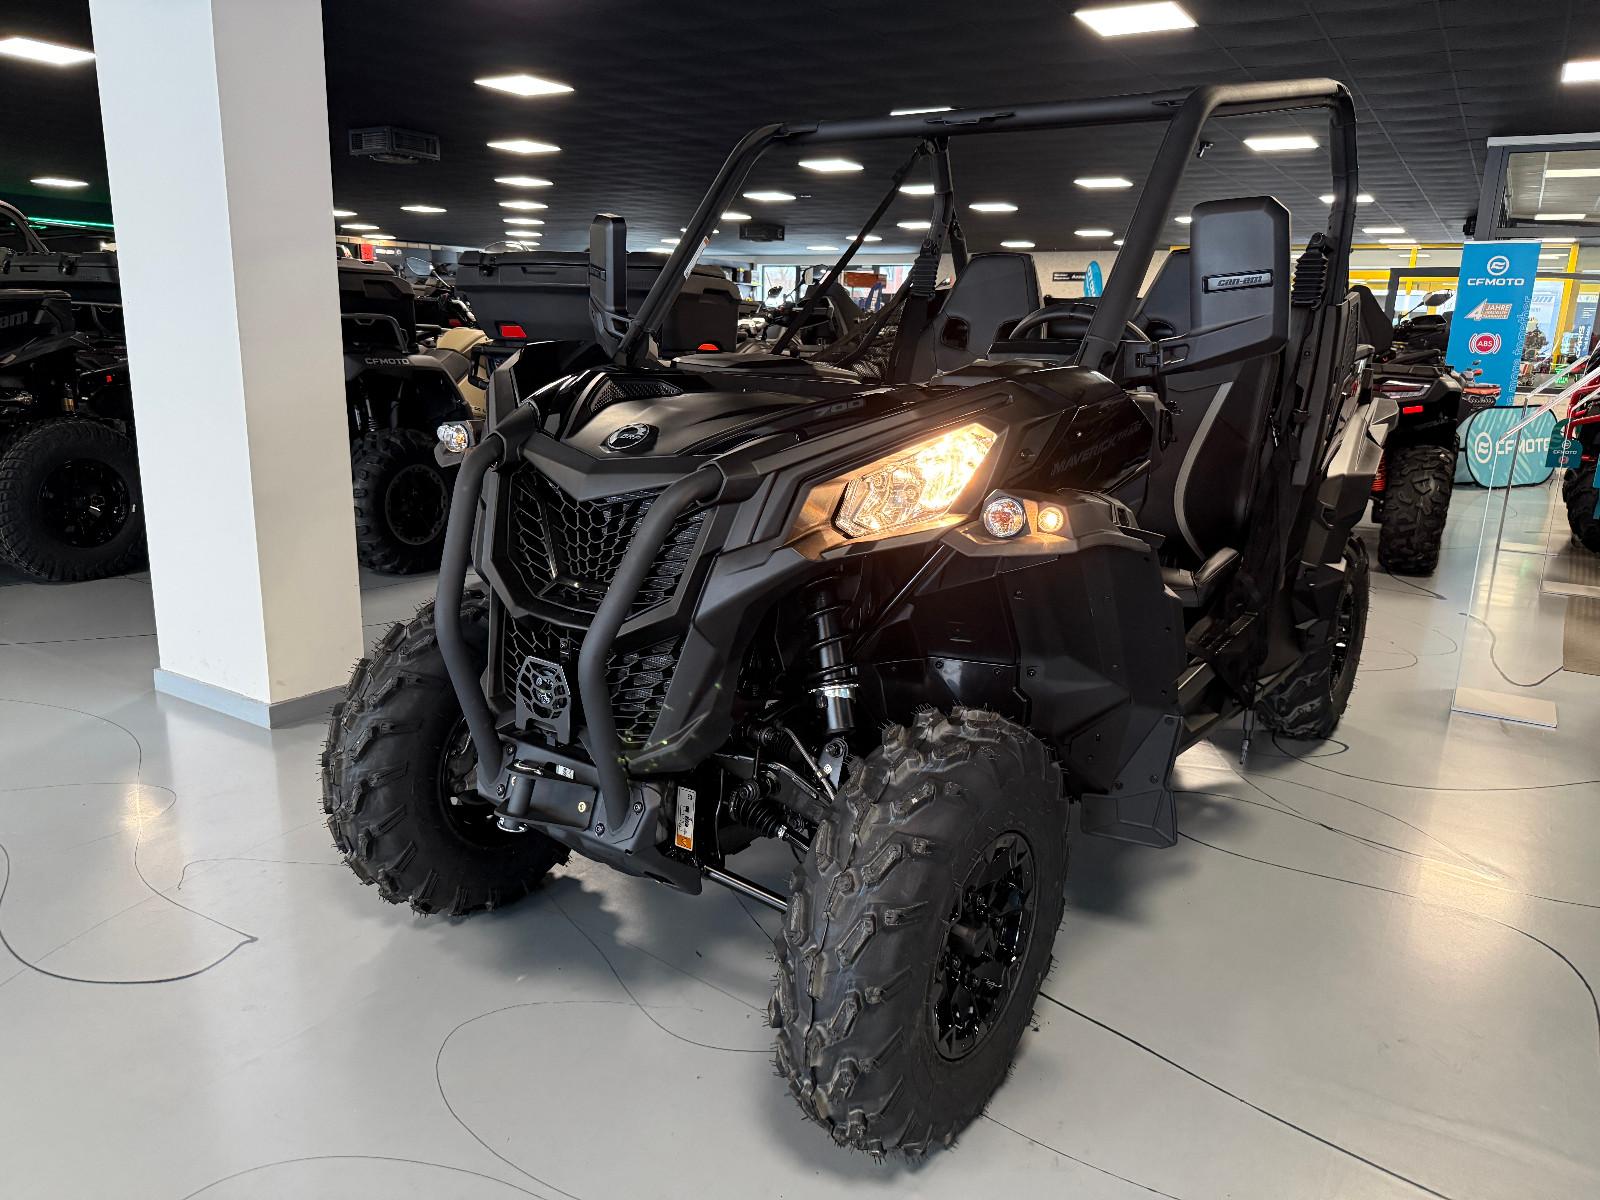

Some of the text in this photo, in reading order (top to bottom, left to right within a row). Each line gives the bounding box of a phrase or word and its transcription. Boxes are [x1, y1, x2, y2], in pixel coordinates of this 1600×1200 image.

[1217, 276, 1263, 287] can-am
[1467, 278, 1525, 286] CFMOTO
[1485, 304, 1512, 312] JAHRE
[1477, 340, 1493, 348] ABS
